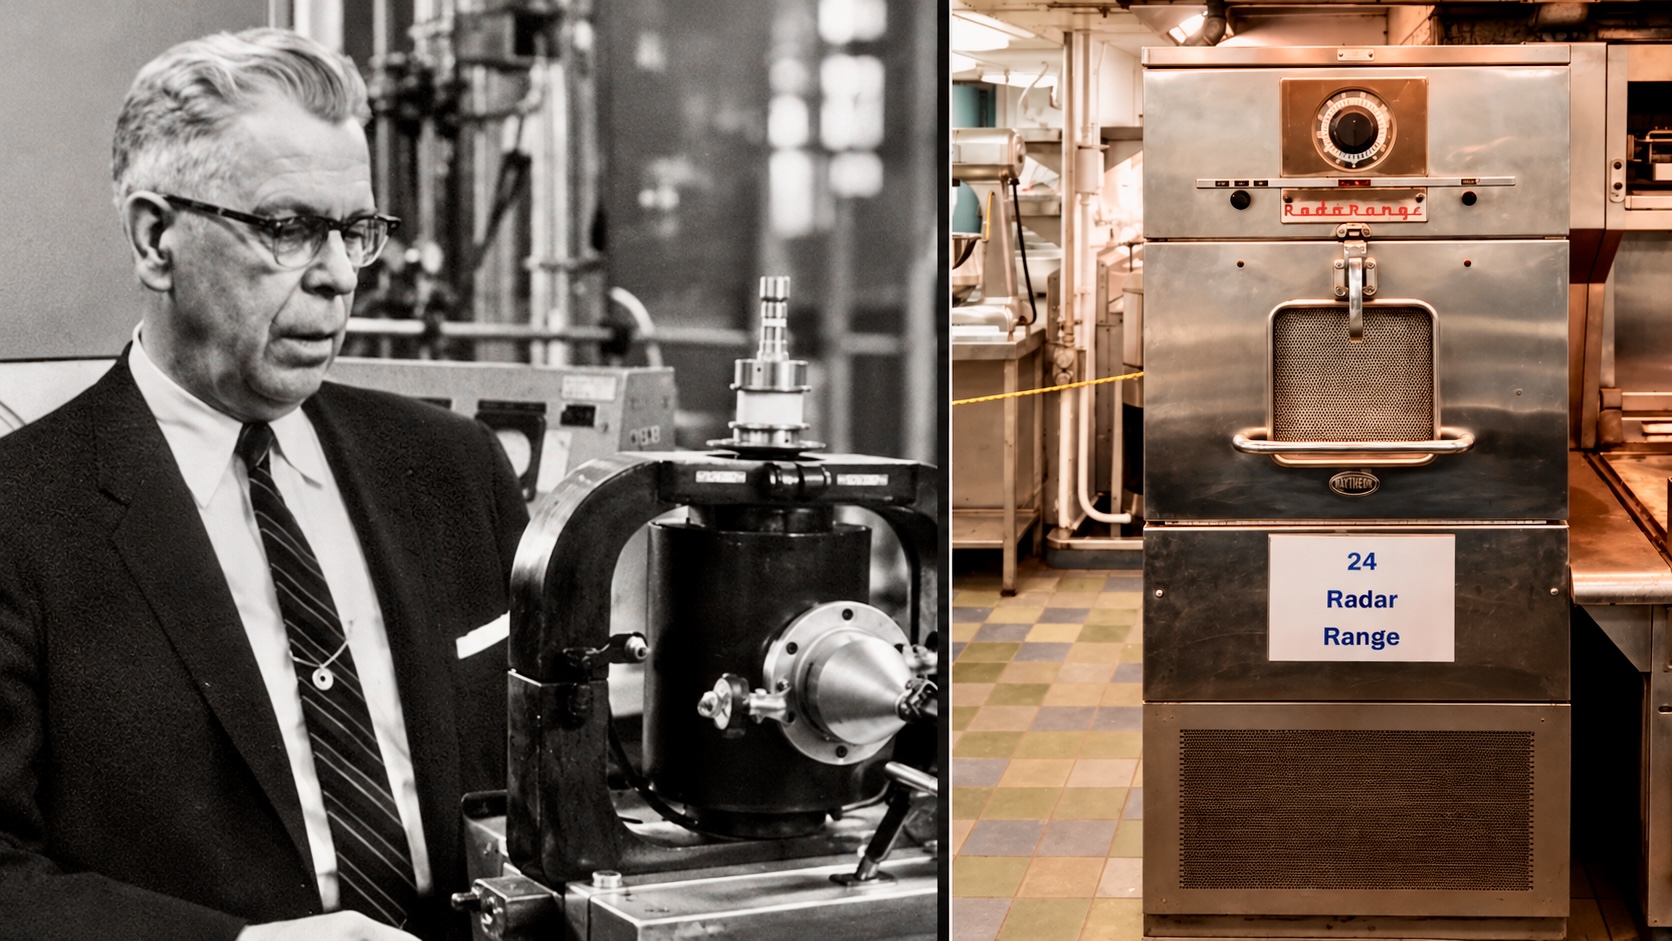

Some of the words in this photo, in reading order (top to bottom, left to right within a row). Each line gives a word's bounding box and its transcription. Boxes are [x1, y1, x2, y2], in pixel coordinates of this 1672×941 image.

[1347, 552, 1377, 571] 24
[1327, 590, 1398, 609] Radar
[1323, 627, 1400, 650] Range
